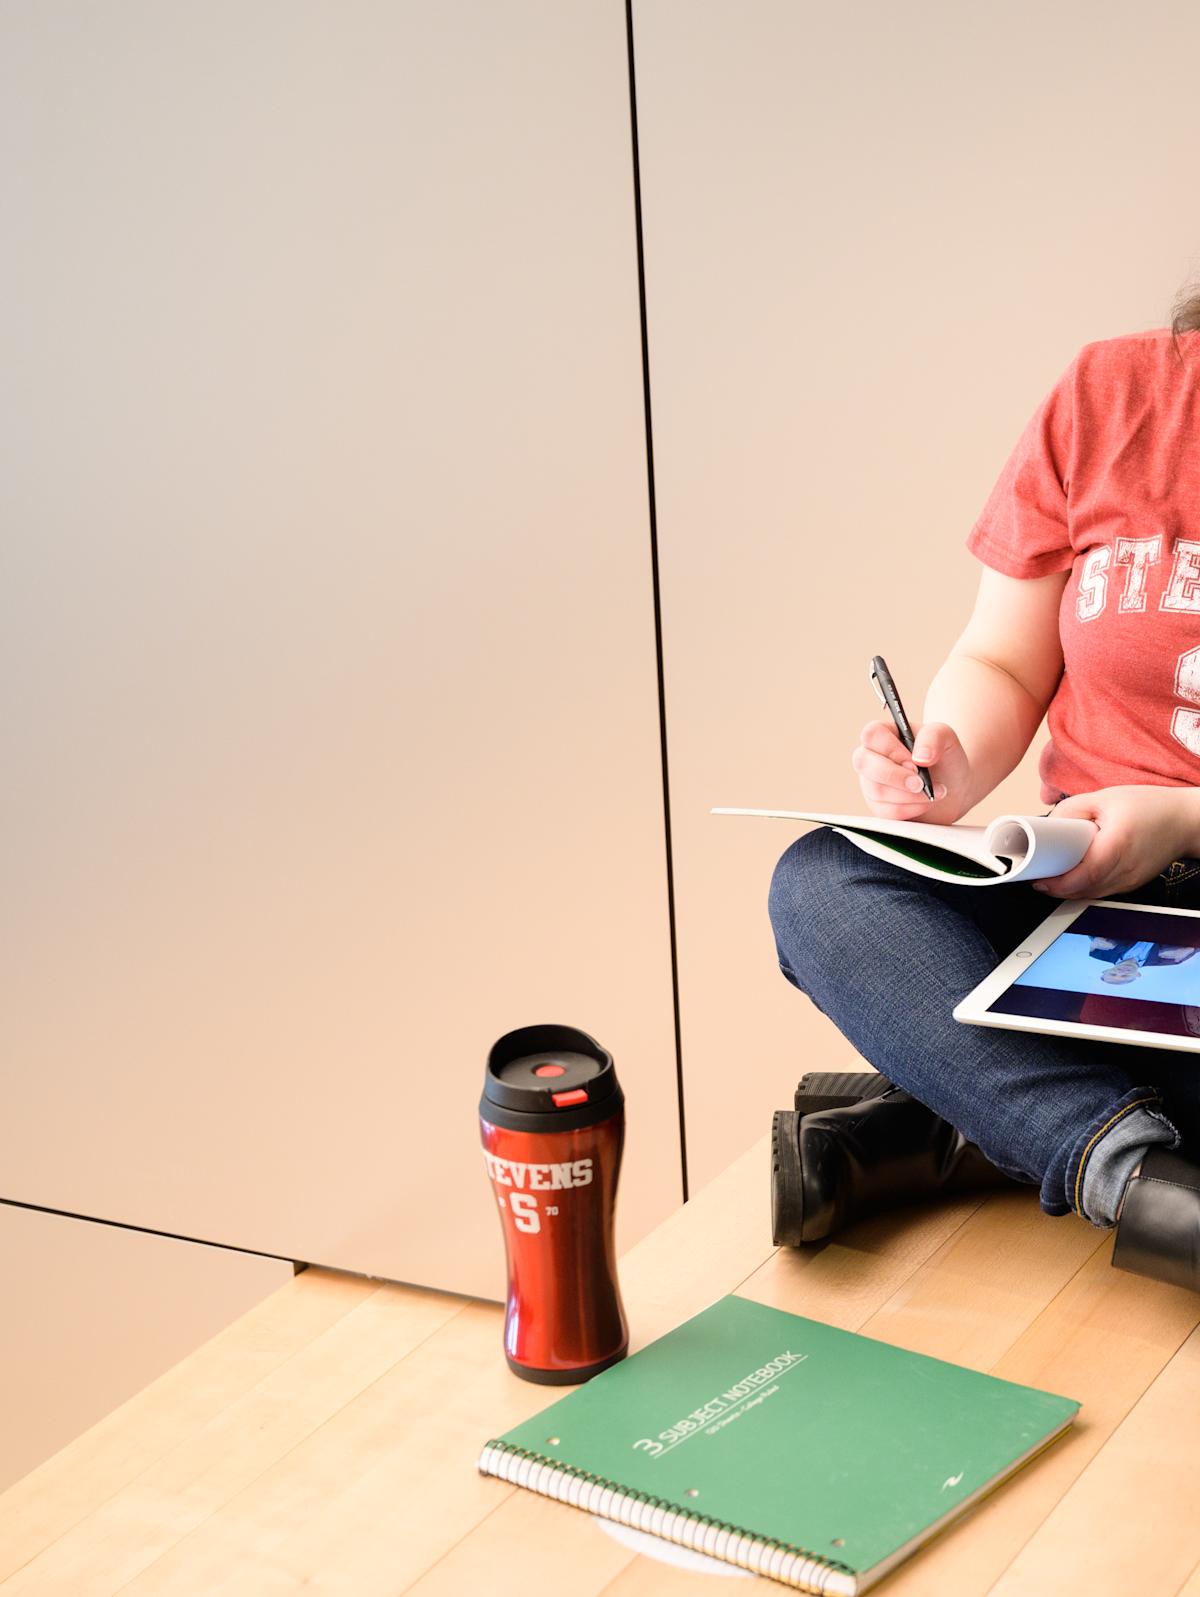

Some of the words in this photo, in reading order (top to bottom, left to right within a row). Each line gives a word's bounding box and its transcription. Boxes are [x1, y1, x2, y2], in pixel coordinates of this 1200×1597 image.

[633, 1438, 664, 1456] 3
[658, 1397, 729, 1444] SUBJECT
[721, 1350, 802, 1401] NOTEBOOK
